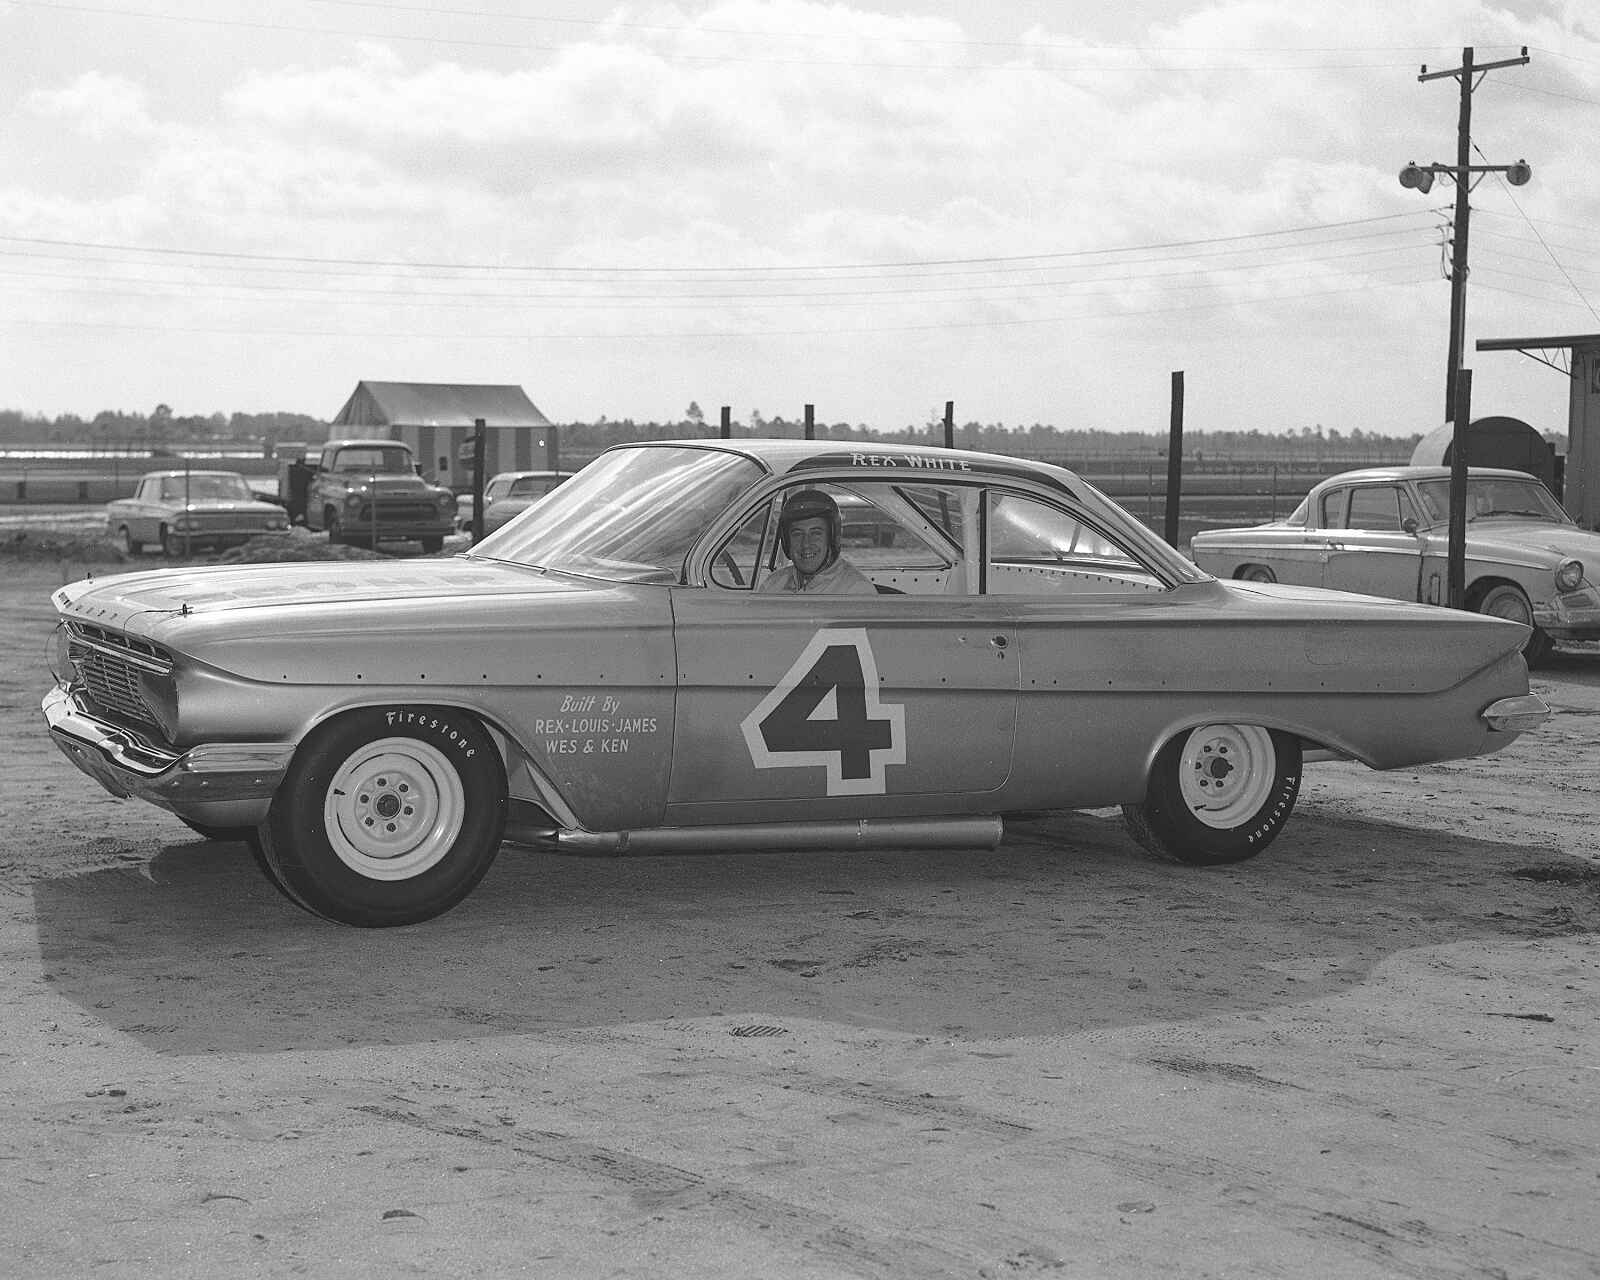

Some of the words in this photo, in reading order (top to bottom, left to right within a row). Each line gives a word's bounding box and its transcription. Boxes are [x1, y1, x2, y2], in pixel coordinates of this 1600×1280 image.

[849, 453, 897, 467] REX
[904, 454, 971, 471] WHITE
[560, 694, 596, 713] Built
[602, 695, 620, 715] By
[740, 628, 906, 796] 4
[385, 710, 476, 758] Firestone
[546, 739, 577, 754] WES
[583, 739, 594, 754] &
[601, 739, 629, 753] KEN
[1248, 776, 1296, 843] Firestone
